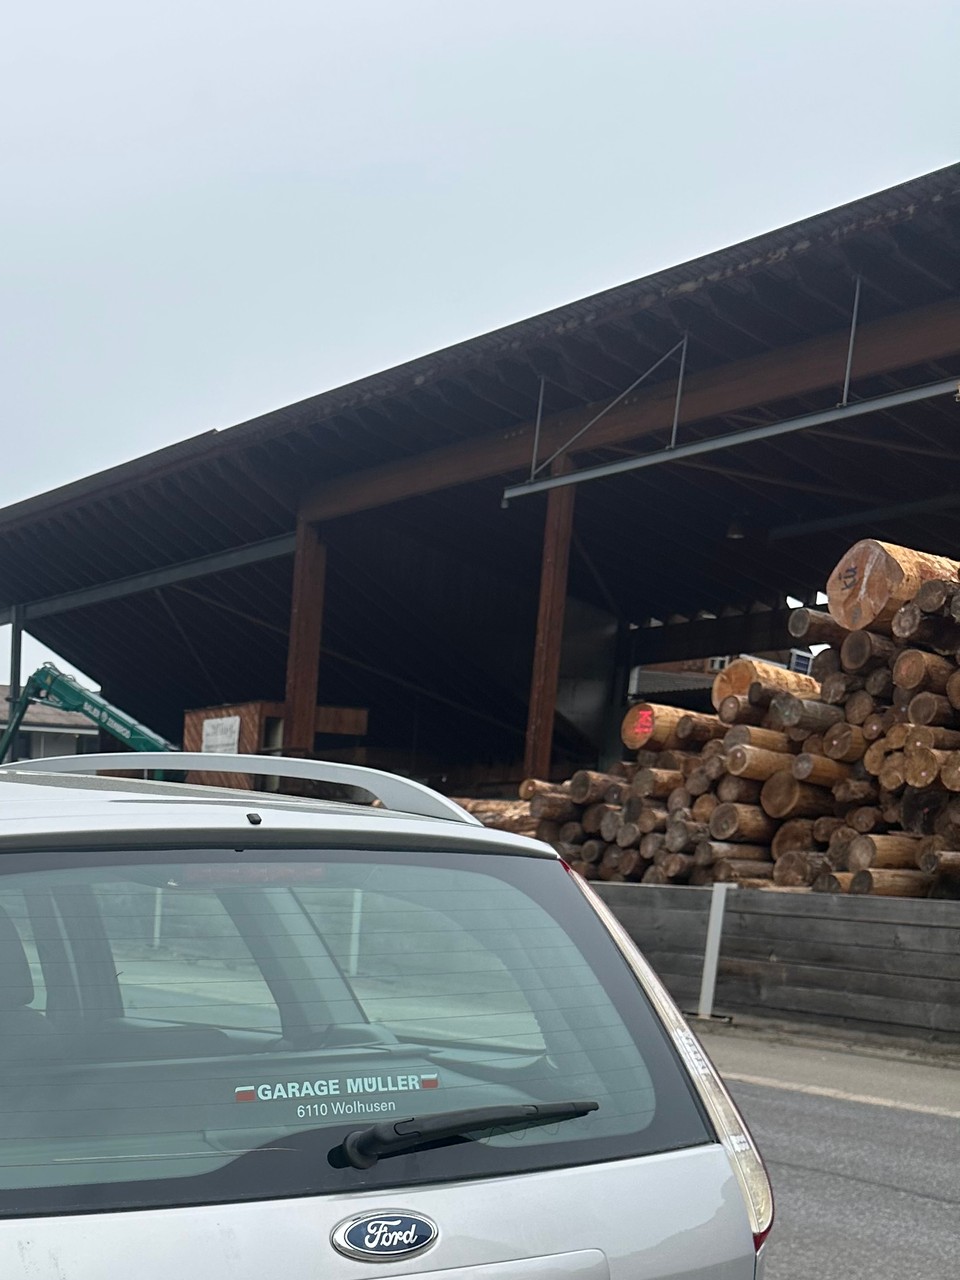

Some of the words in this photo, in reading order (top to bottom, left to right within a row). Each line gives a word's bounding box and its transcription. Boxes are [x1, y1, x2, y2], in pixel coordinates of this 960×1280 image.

[257, 1079, 340, 1101] GARAGE
[347, 1074, 420, 1094] MÜLLER
[297, 1103, 328, 1118] 6110
[331, 1100, 396, 1115] Wolhusen
[364, 1219, 418, 1249] Ford
